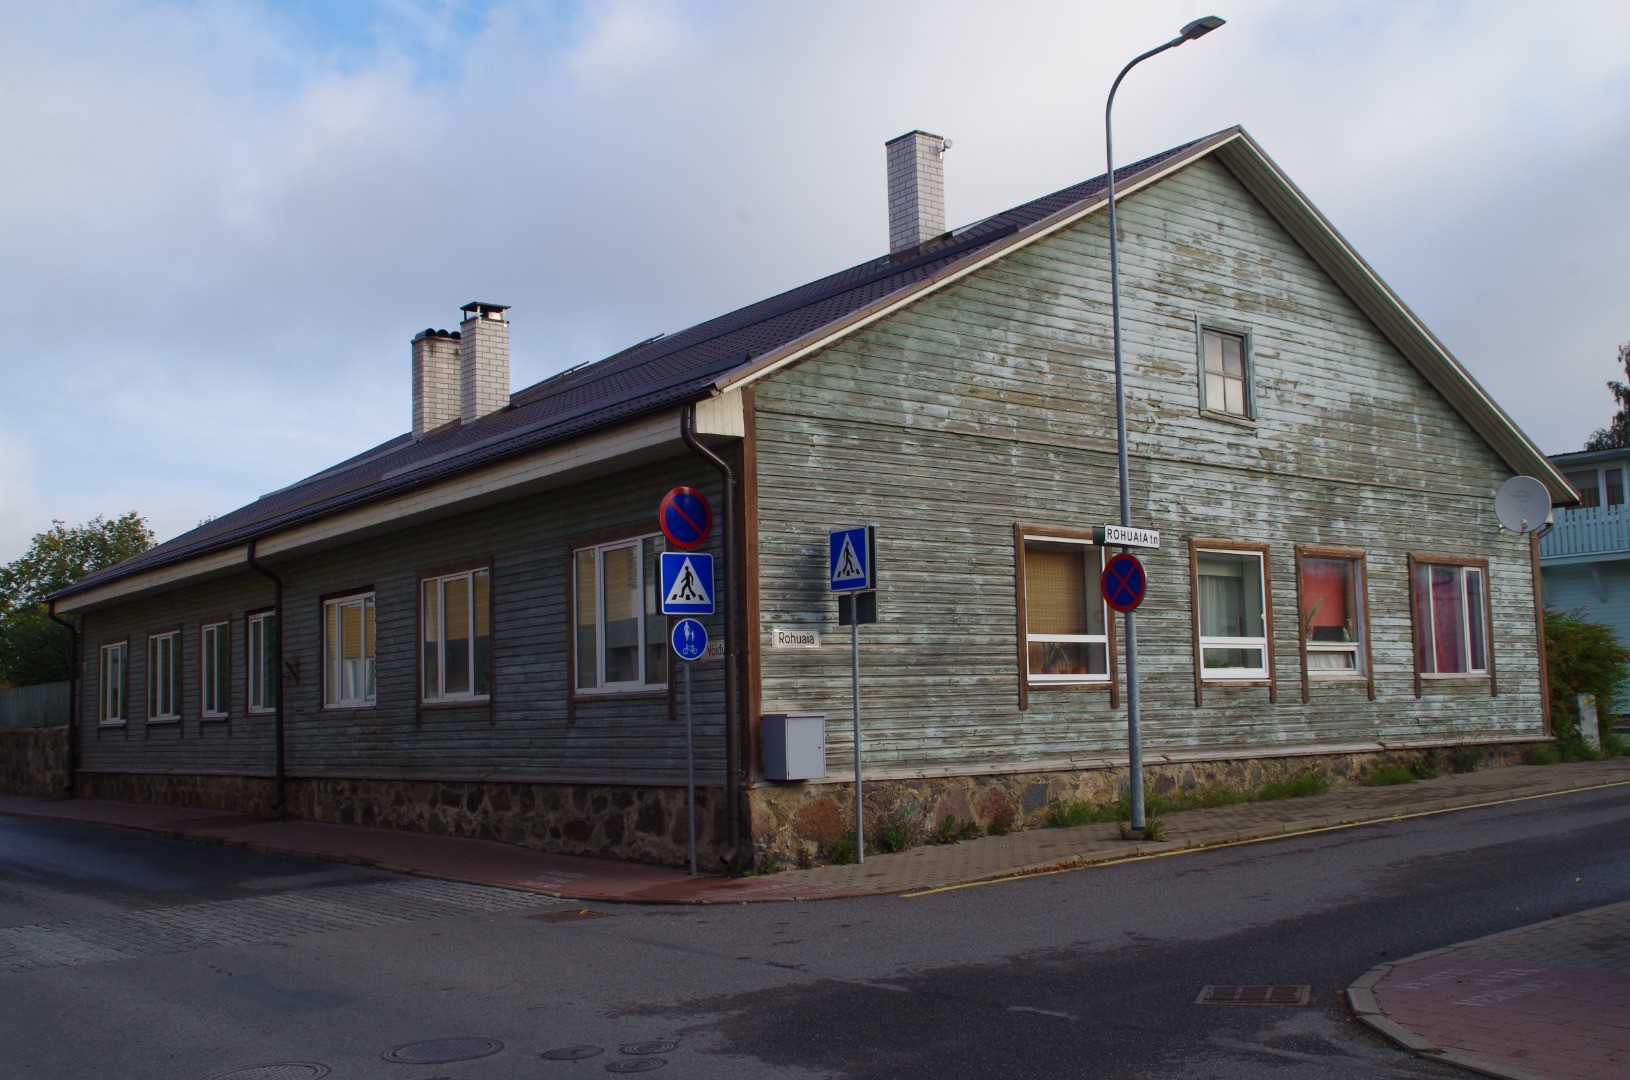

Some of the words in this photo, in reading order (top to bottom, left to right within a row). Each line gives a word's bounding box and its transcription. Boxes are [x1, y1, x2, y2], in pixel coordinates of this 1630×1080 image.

[1107, 528, 1149, 543] ROHUAIA
[1150, 535, 1159, 544] tn
[779, 631, 815, 644] Rohuaia
